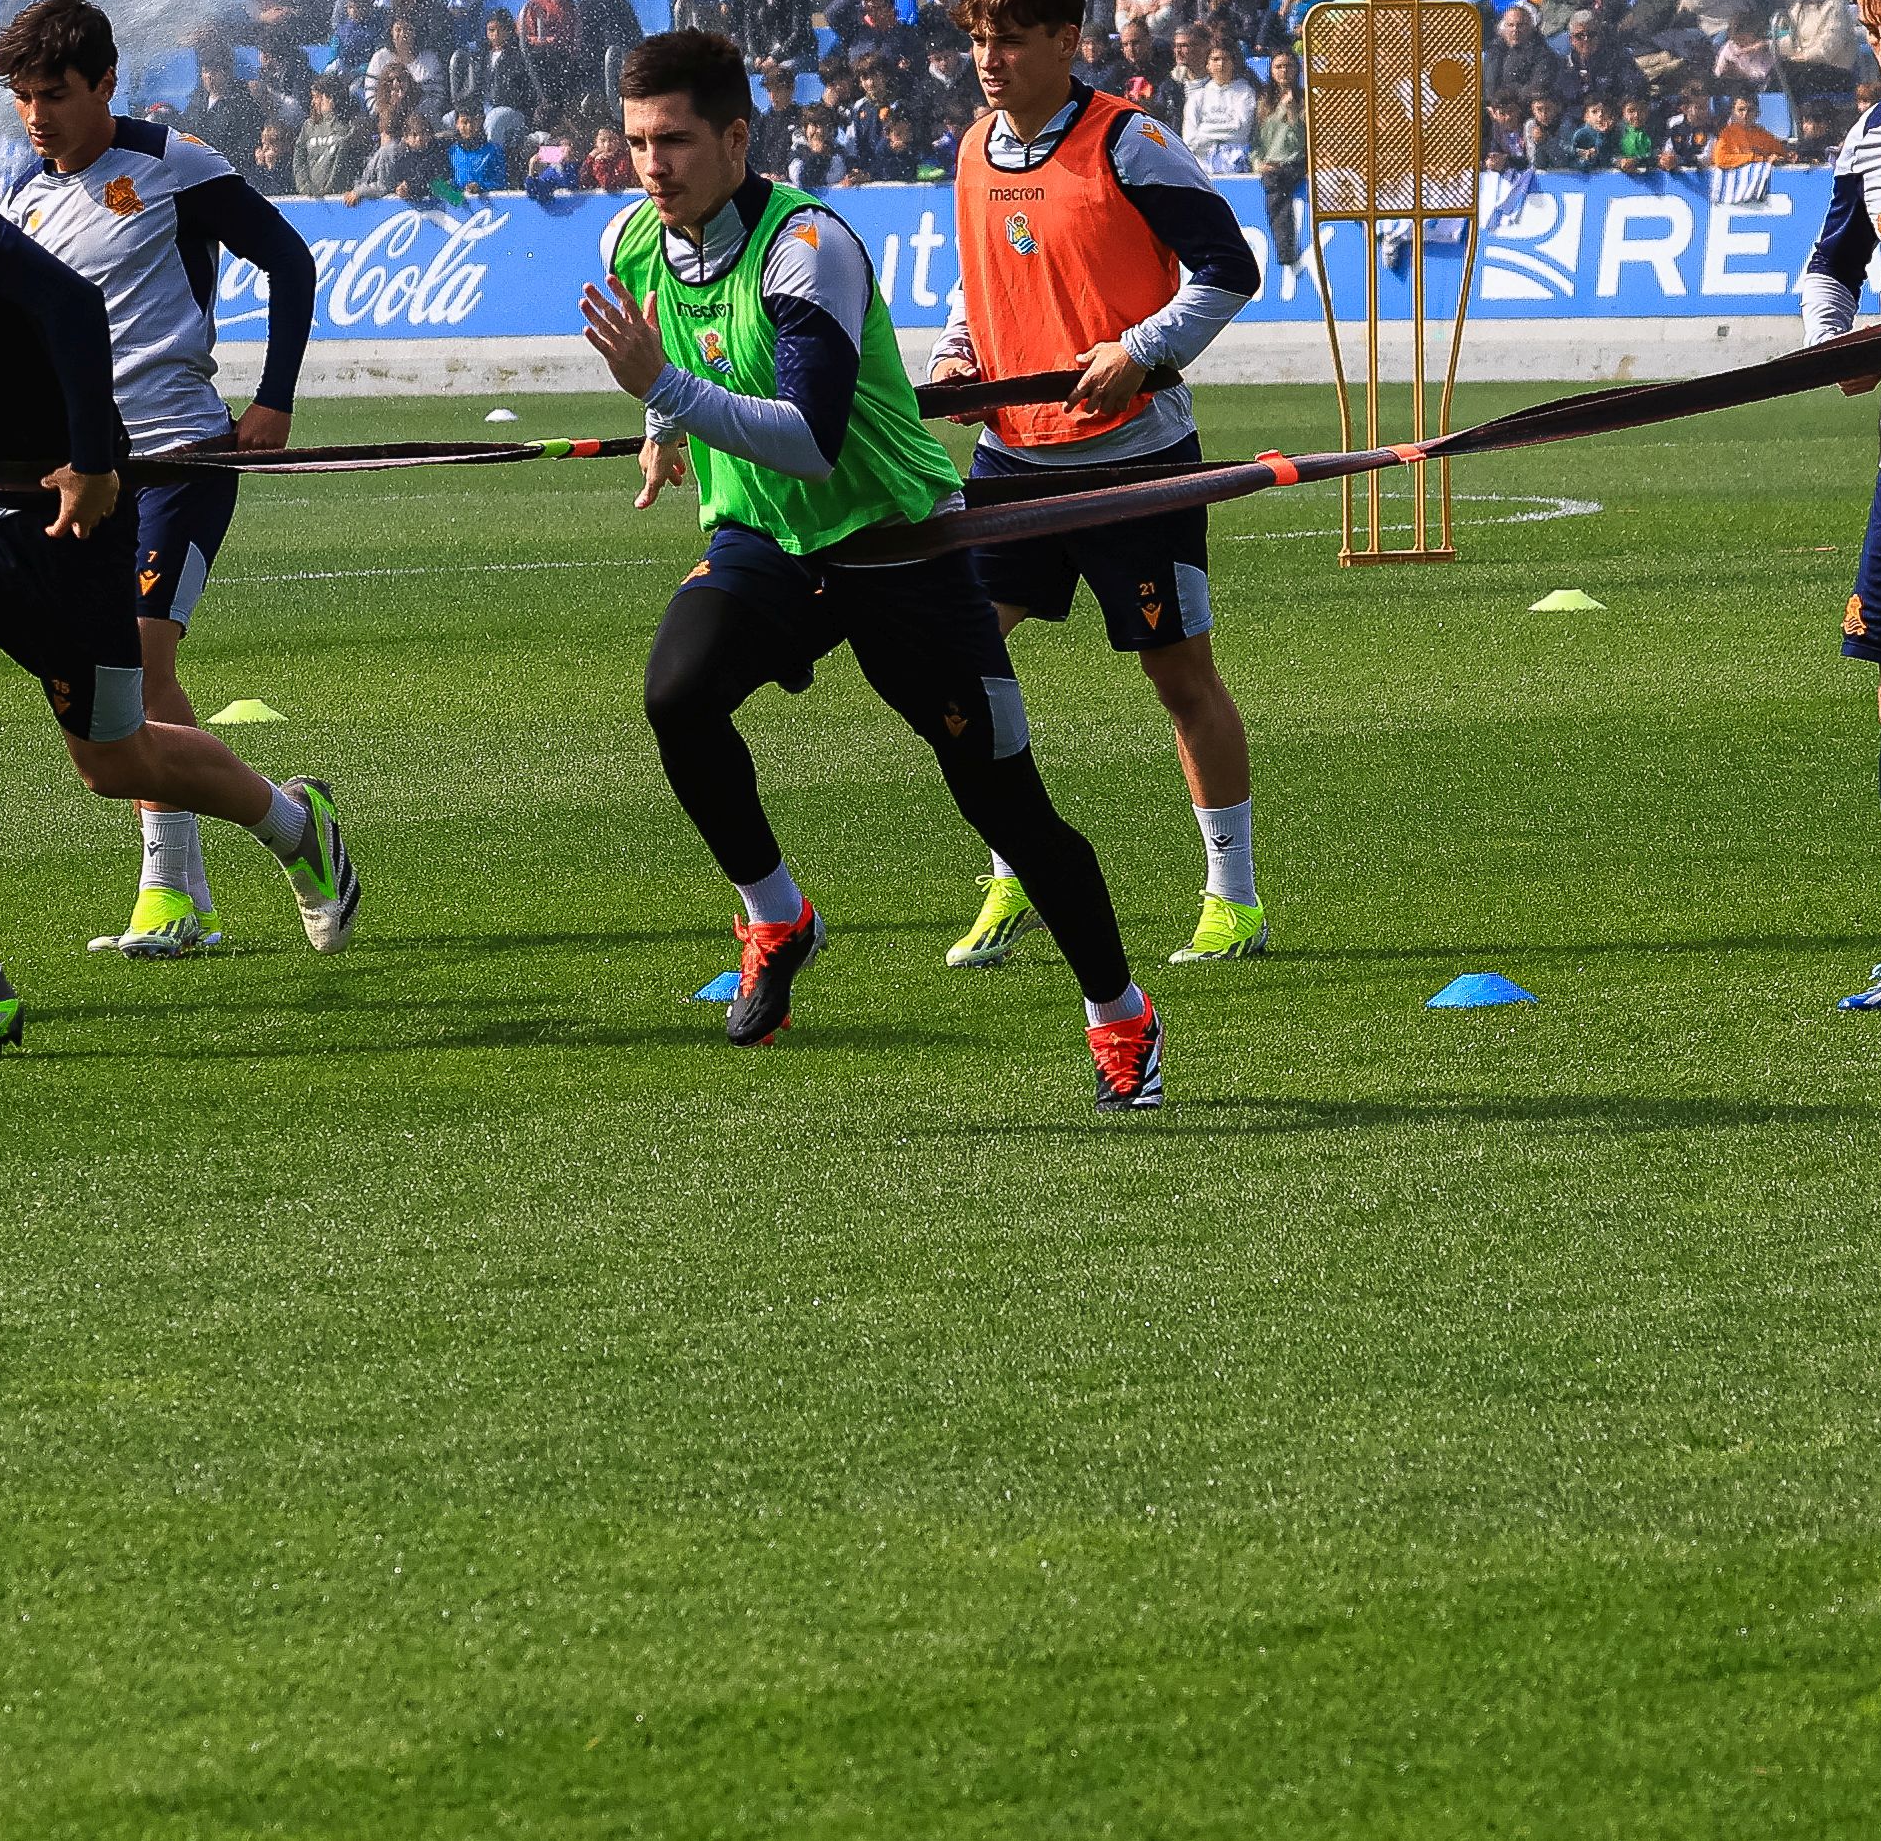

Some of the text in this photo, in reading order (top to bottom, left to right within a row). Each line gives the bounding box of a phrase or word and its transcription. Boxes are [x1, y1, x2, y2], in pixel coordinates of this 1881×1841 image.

[989, 187, 1044, 201] macron
[147, 550, 158, 563] 7
[1139, 582, 1155, 596] 21
